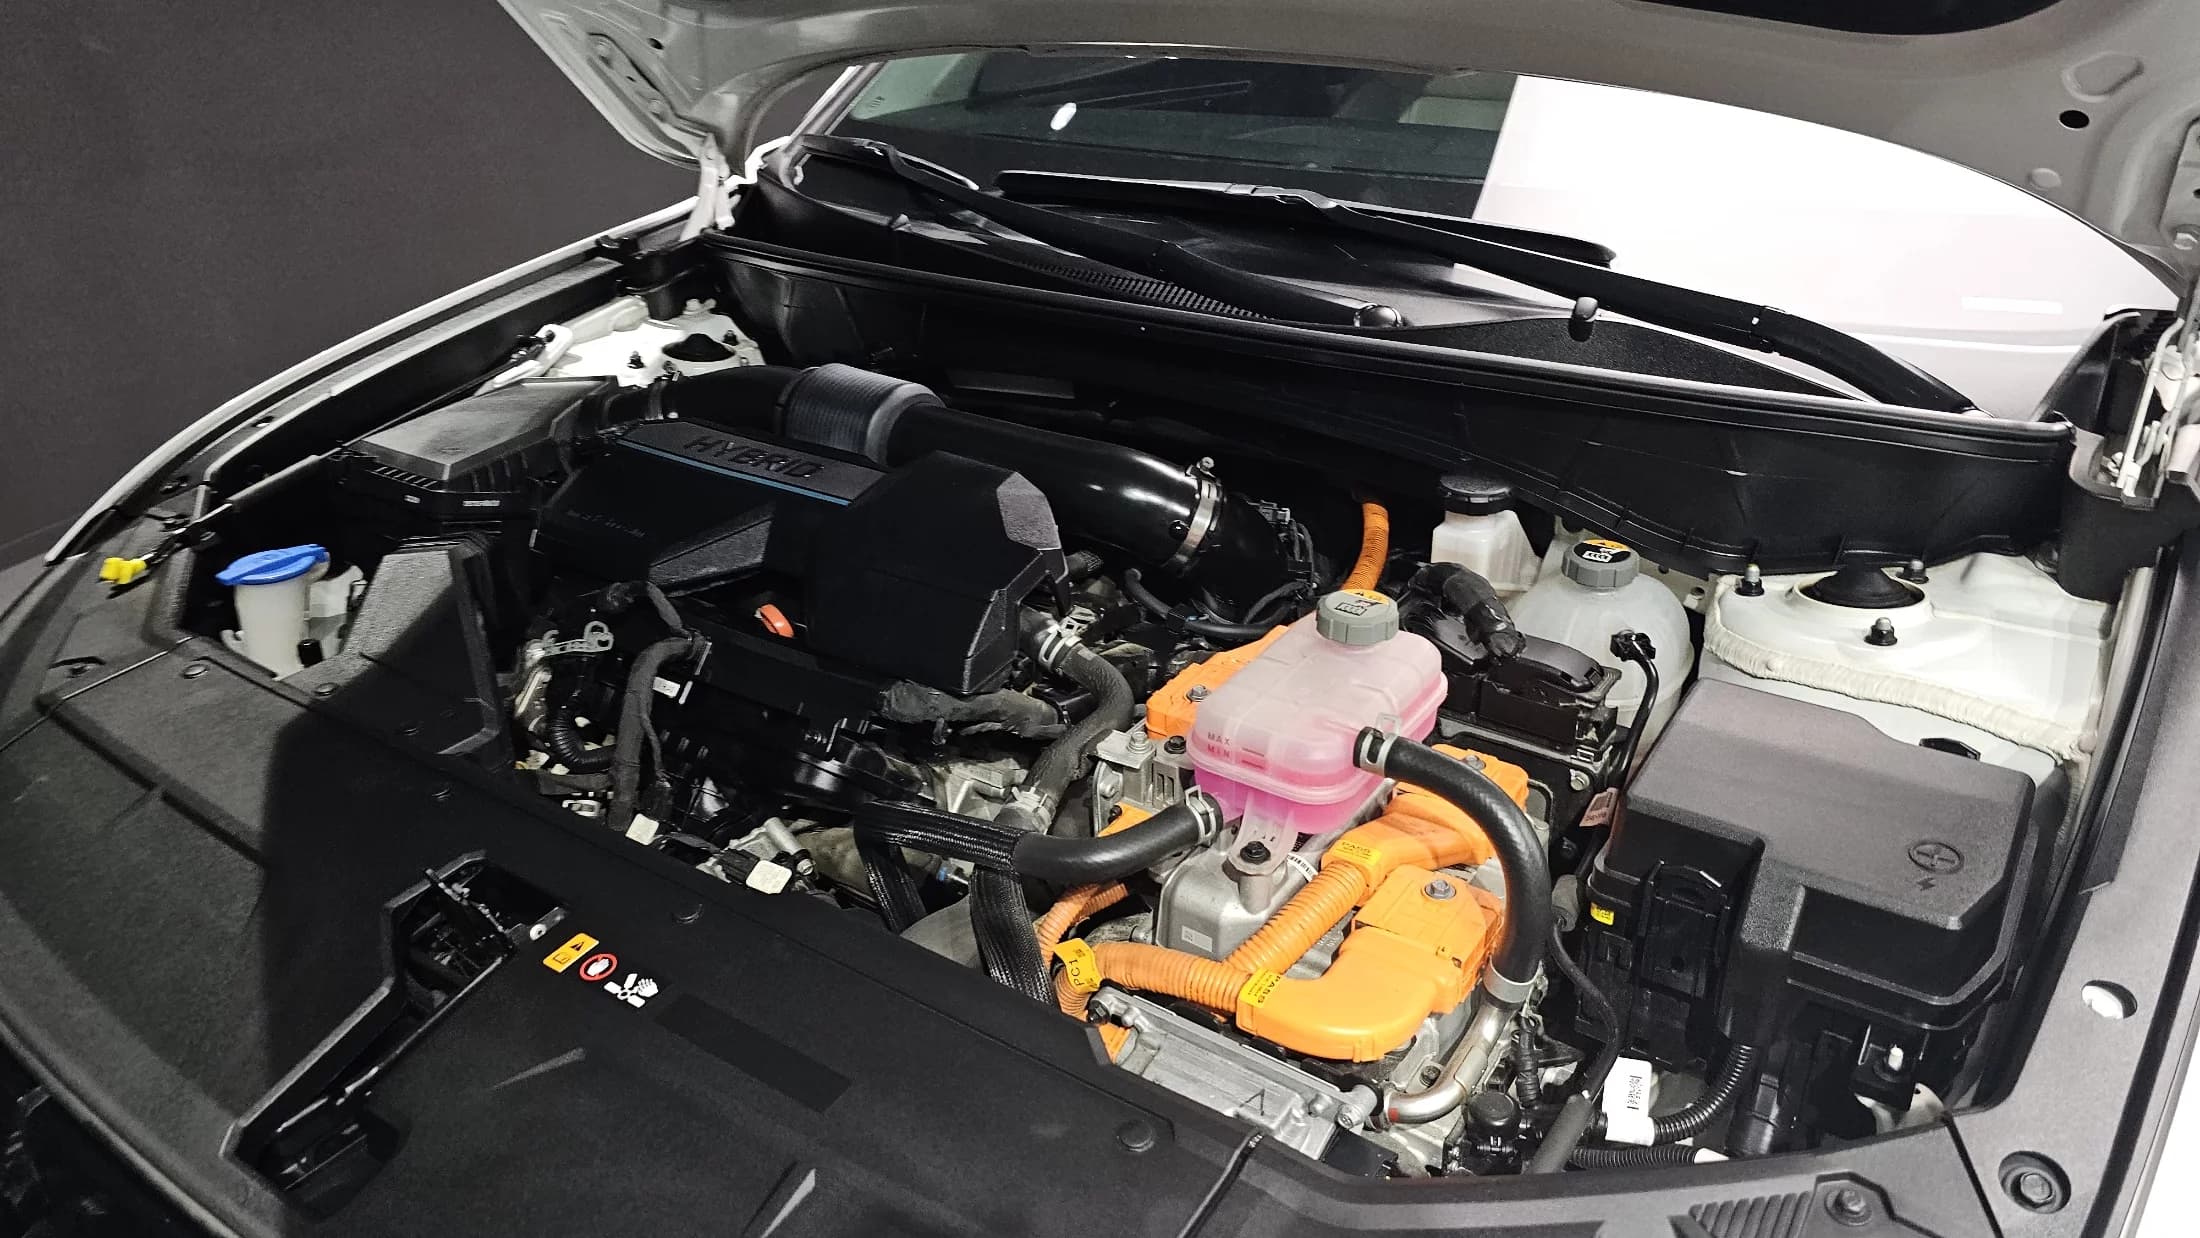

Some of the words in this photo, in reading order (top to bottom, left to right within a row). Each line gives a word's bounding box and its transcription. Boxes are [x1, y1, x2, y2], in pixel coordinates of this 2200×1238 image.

[683, 434, 825, 479] HYBRID
[1207, 731, 1231, 745] MAX
[1207, 743, 1230, 758] MIN
